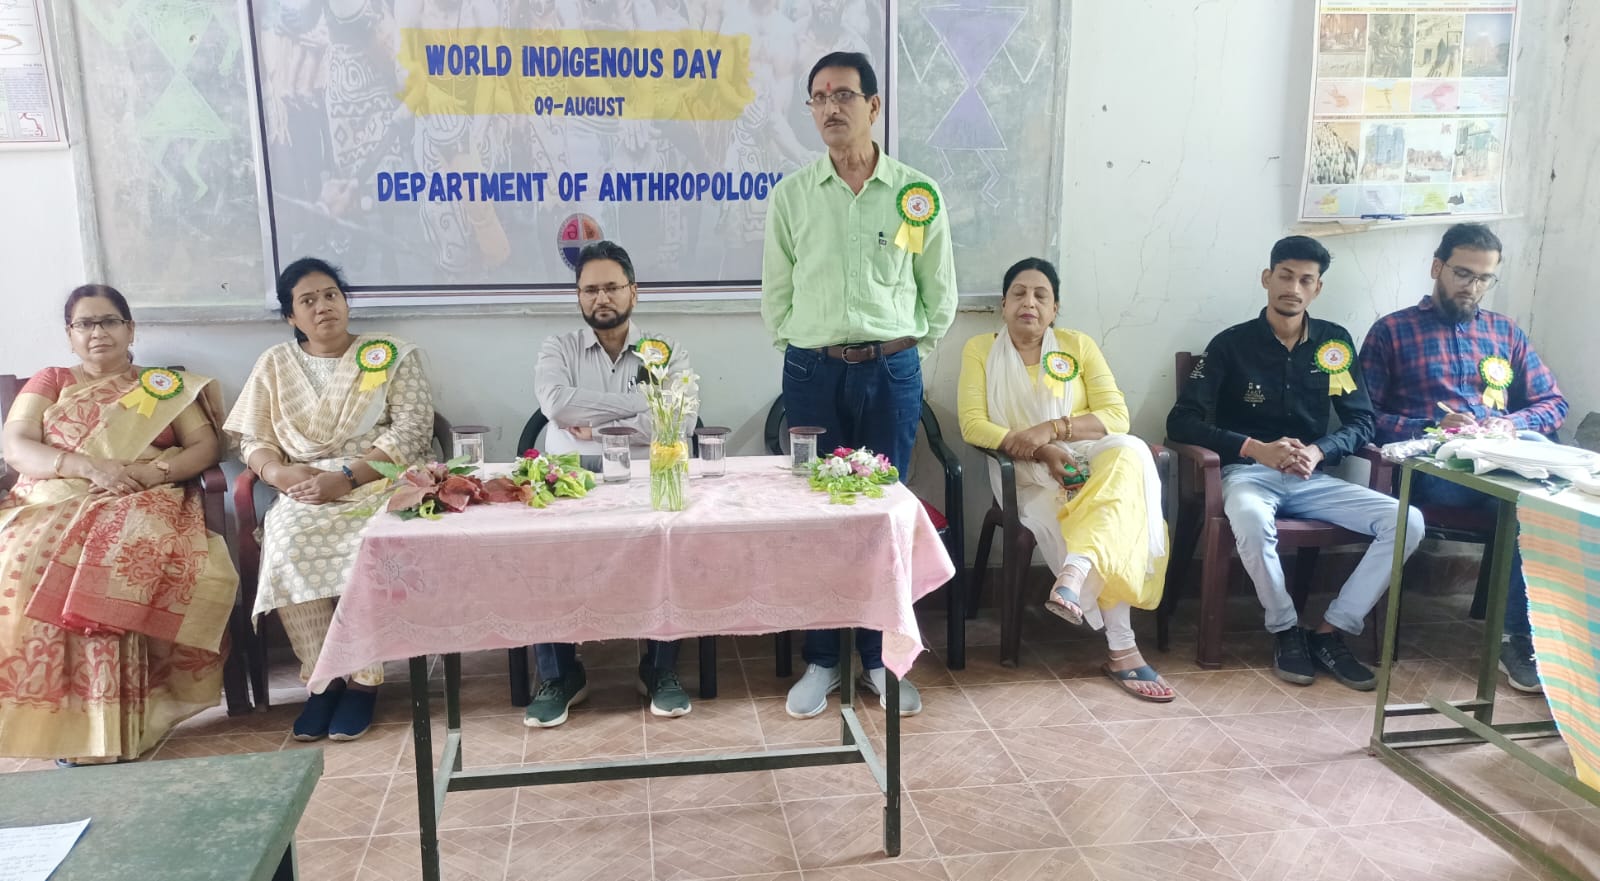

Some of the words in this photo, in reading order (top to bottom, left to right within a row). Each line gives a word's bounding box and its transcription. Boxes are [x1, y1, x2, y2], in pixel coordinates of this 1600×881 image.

[426, 44, 512, 76] WORLD
[522, 46, 663, 78] INDIGENOUS
[673, 49, 722, 80] DAY
[534, 97, 625, 116] 09-AUGUST
[377, 171, 548, 202] DEPARTMENT
[558, 171, 589, 201] OF
[598, 171, 784, 201] ANTHROPOLOGY
